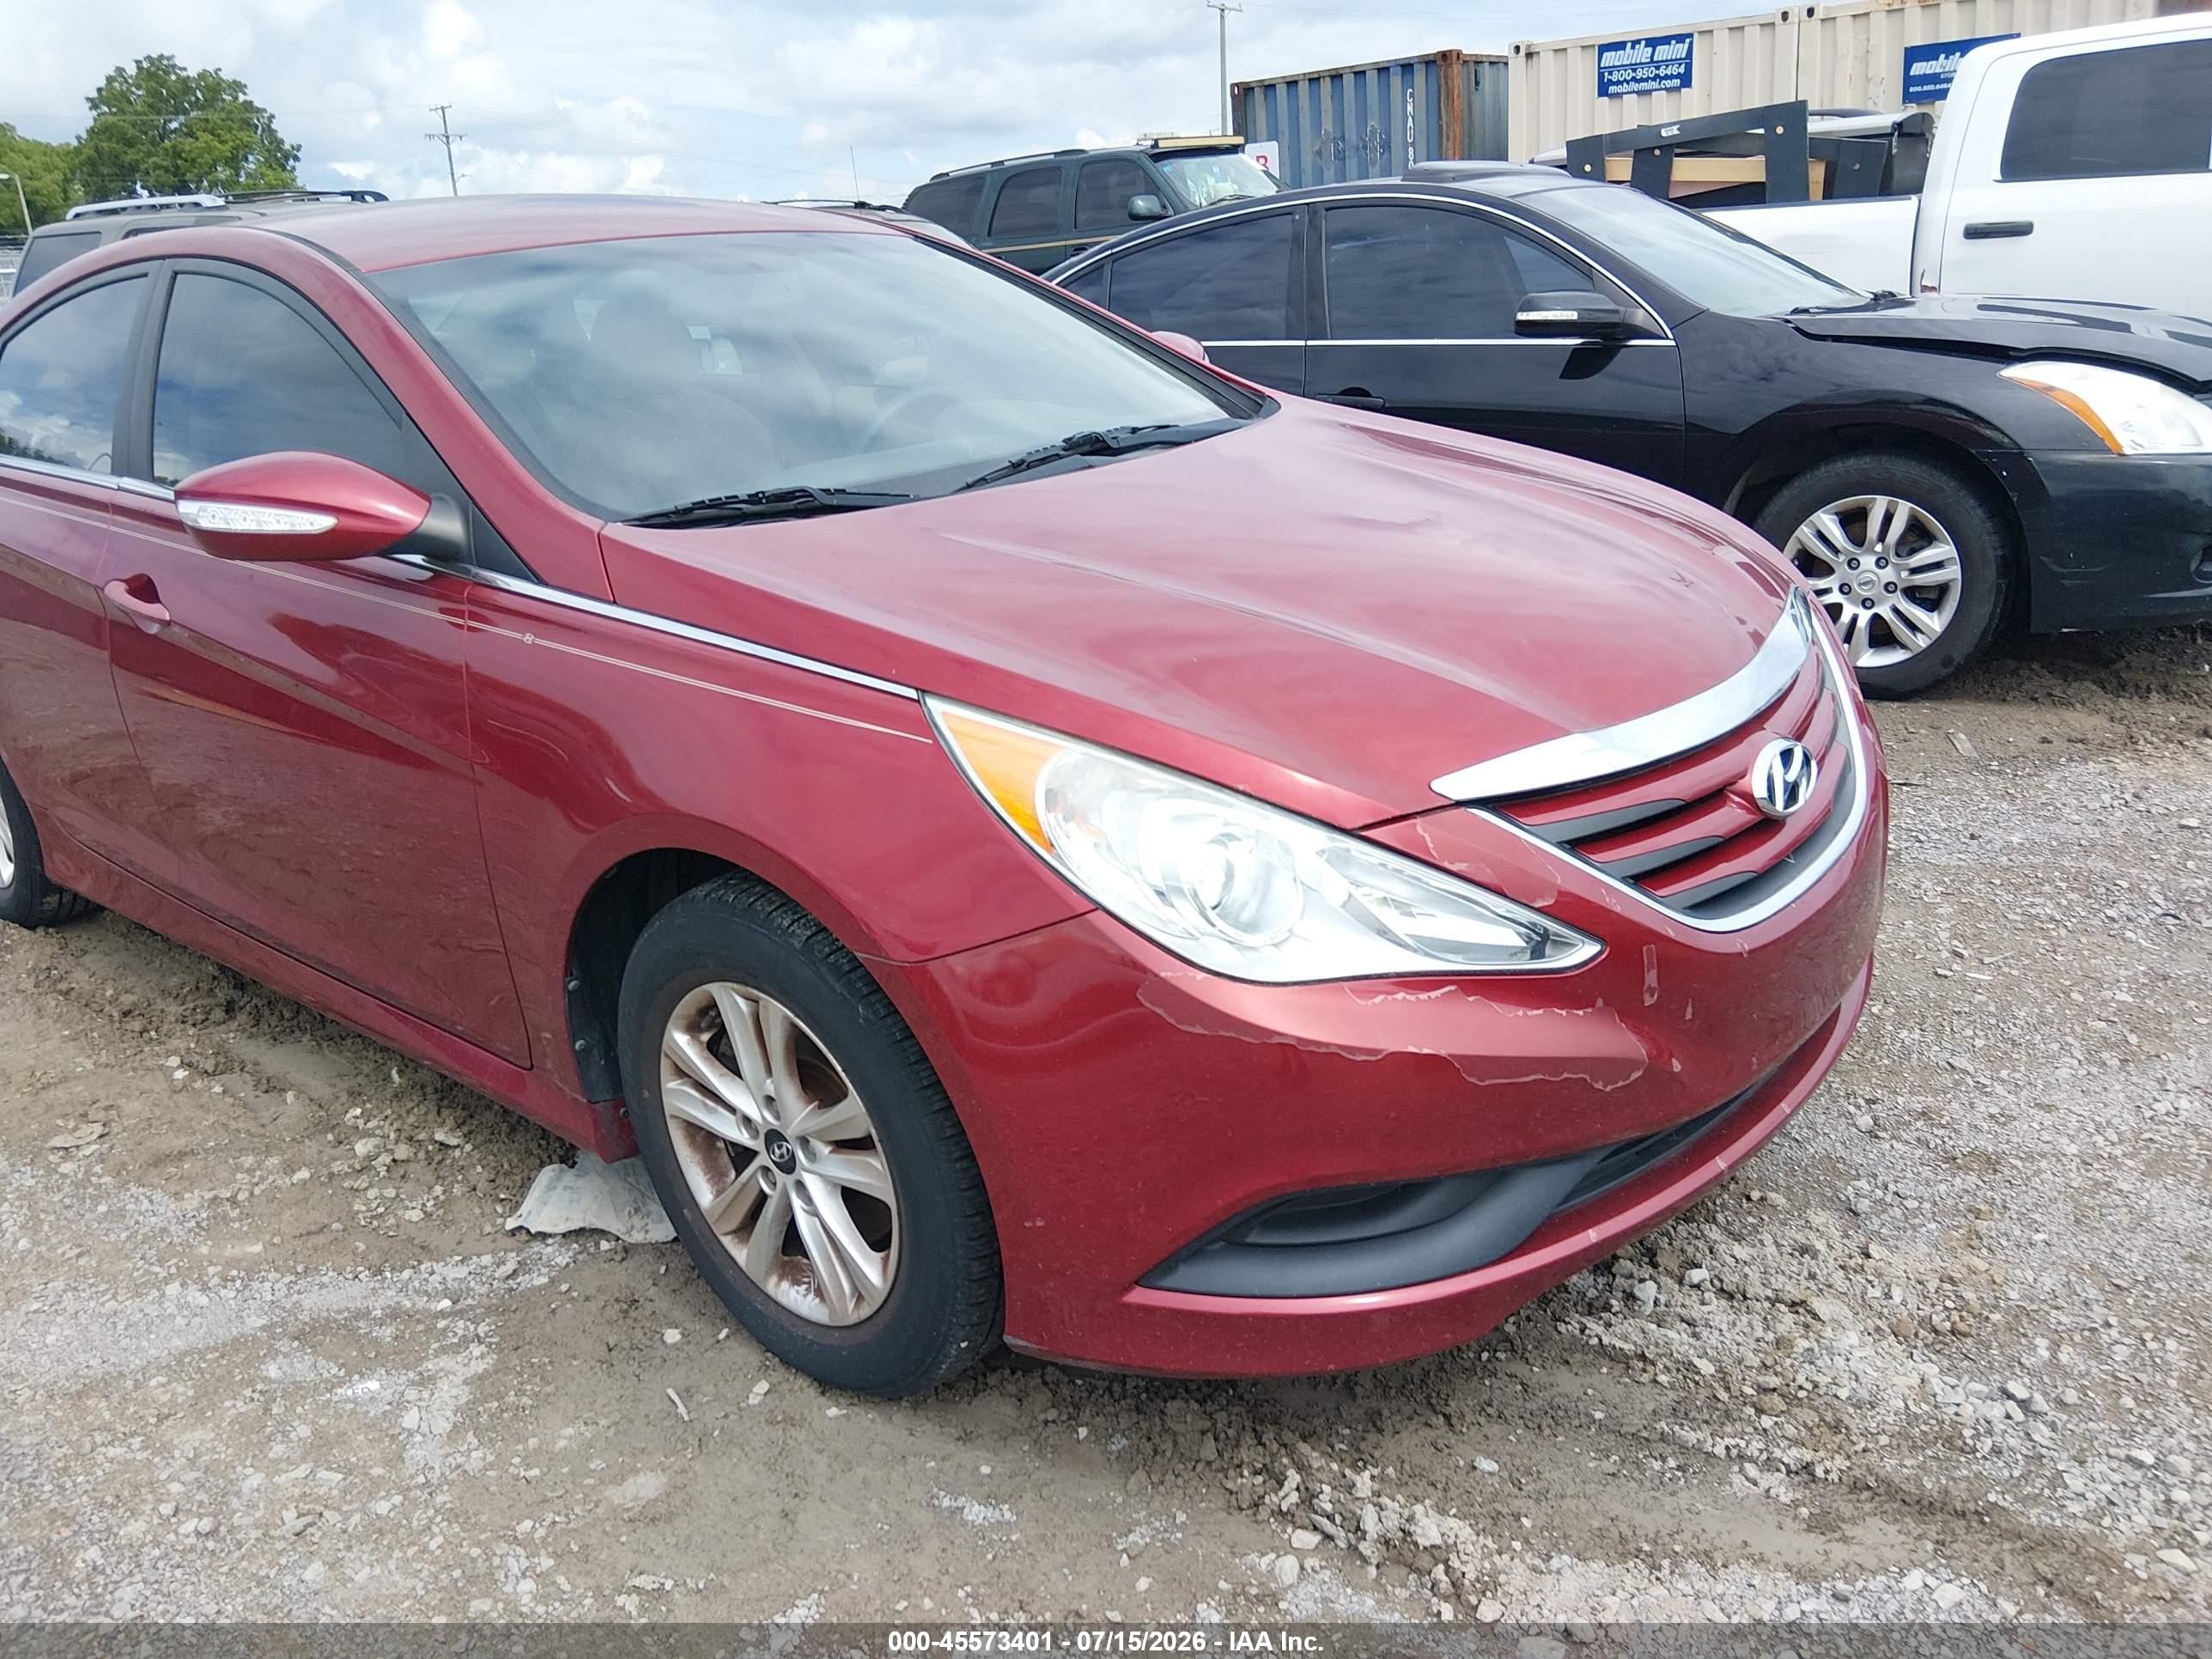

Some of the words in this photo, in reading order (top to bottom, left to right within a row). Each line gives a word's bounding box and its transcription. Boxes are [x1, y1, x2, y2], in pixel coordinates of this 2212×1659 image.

[1600, 41, 1653, 67] mobile
[1653, 38, 1691, 61] mini
[1603, 64, 1686, 82] 1-800-950-6464
[1607, 78, 1680, 94] mobilemini.com
